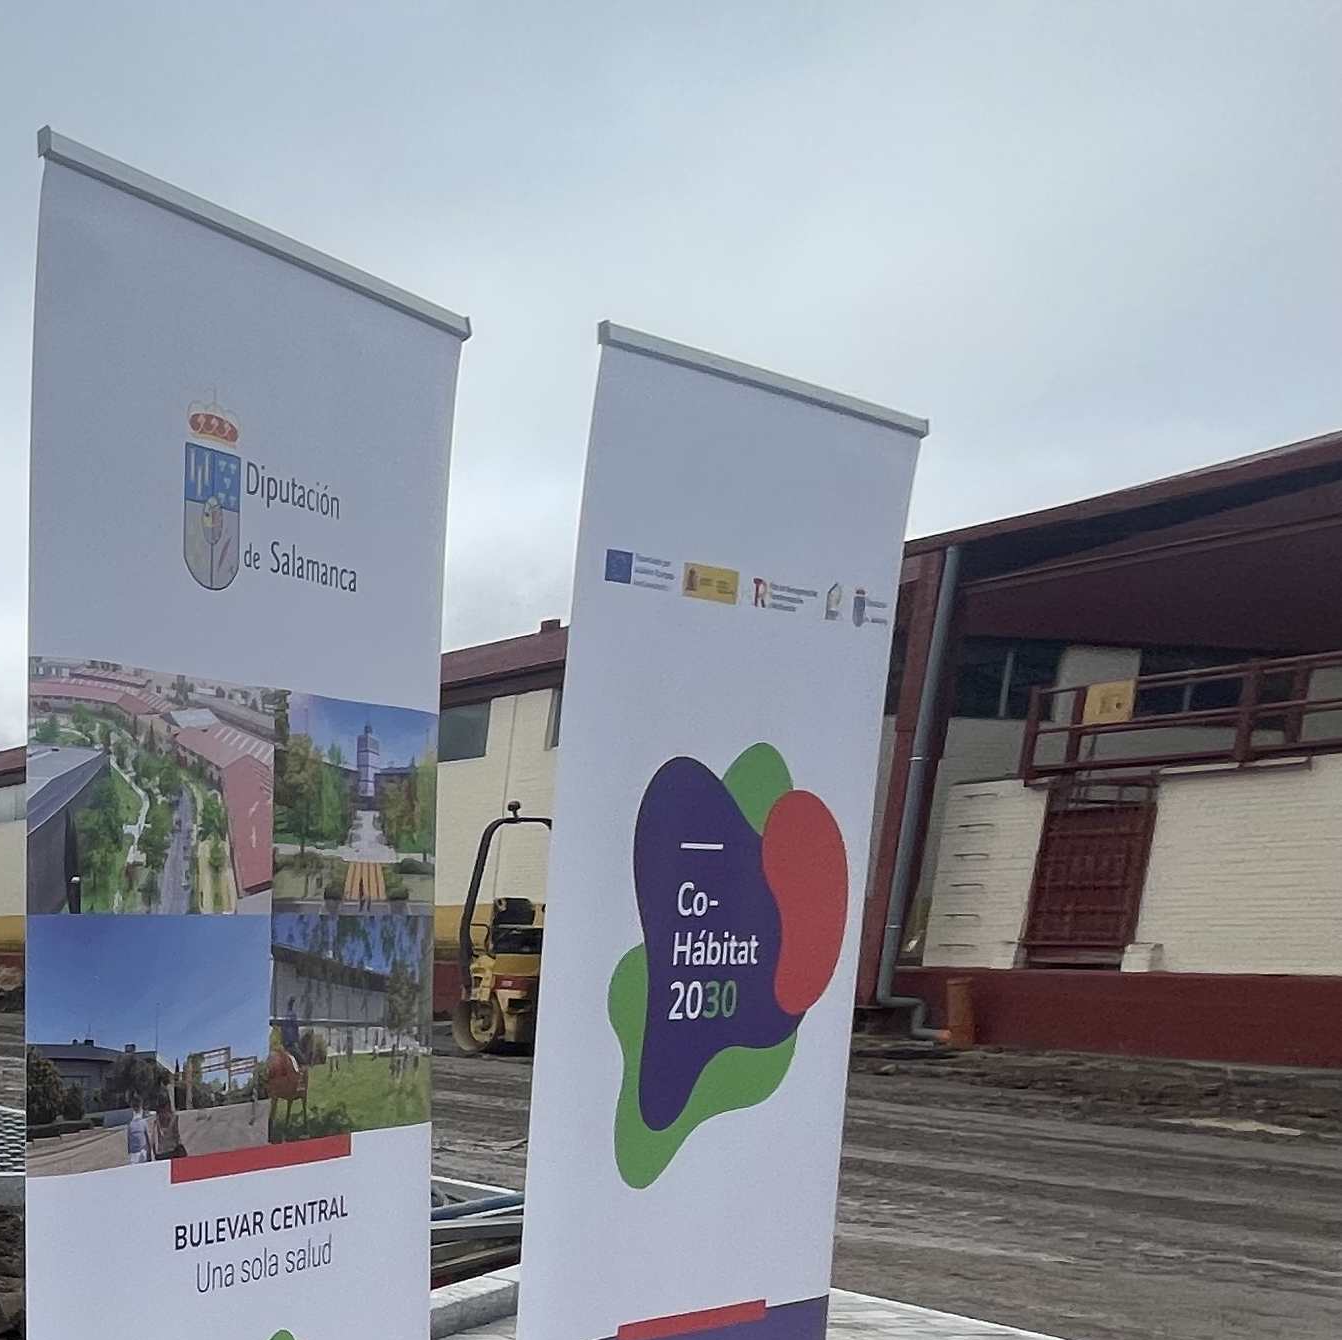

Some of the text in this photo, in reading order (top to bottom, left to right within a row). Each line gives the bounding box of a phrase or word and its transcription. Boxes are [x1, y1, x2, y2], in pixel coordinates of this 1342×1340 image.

[246, 462, 341, 520] Diputación
[244, 541, 358, 593] de Salamanca
[677, 881, 719, 917] Co-
[672, 928, 760, 966] Hábitat
[668, 979, 737, 1021] 2030
[174, 1195, 348, 1251] BULEVAR CENTRAL
[196, 1233, 333, 1293] Una sola salud
